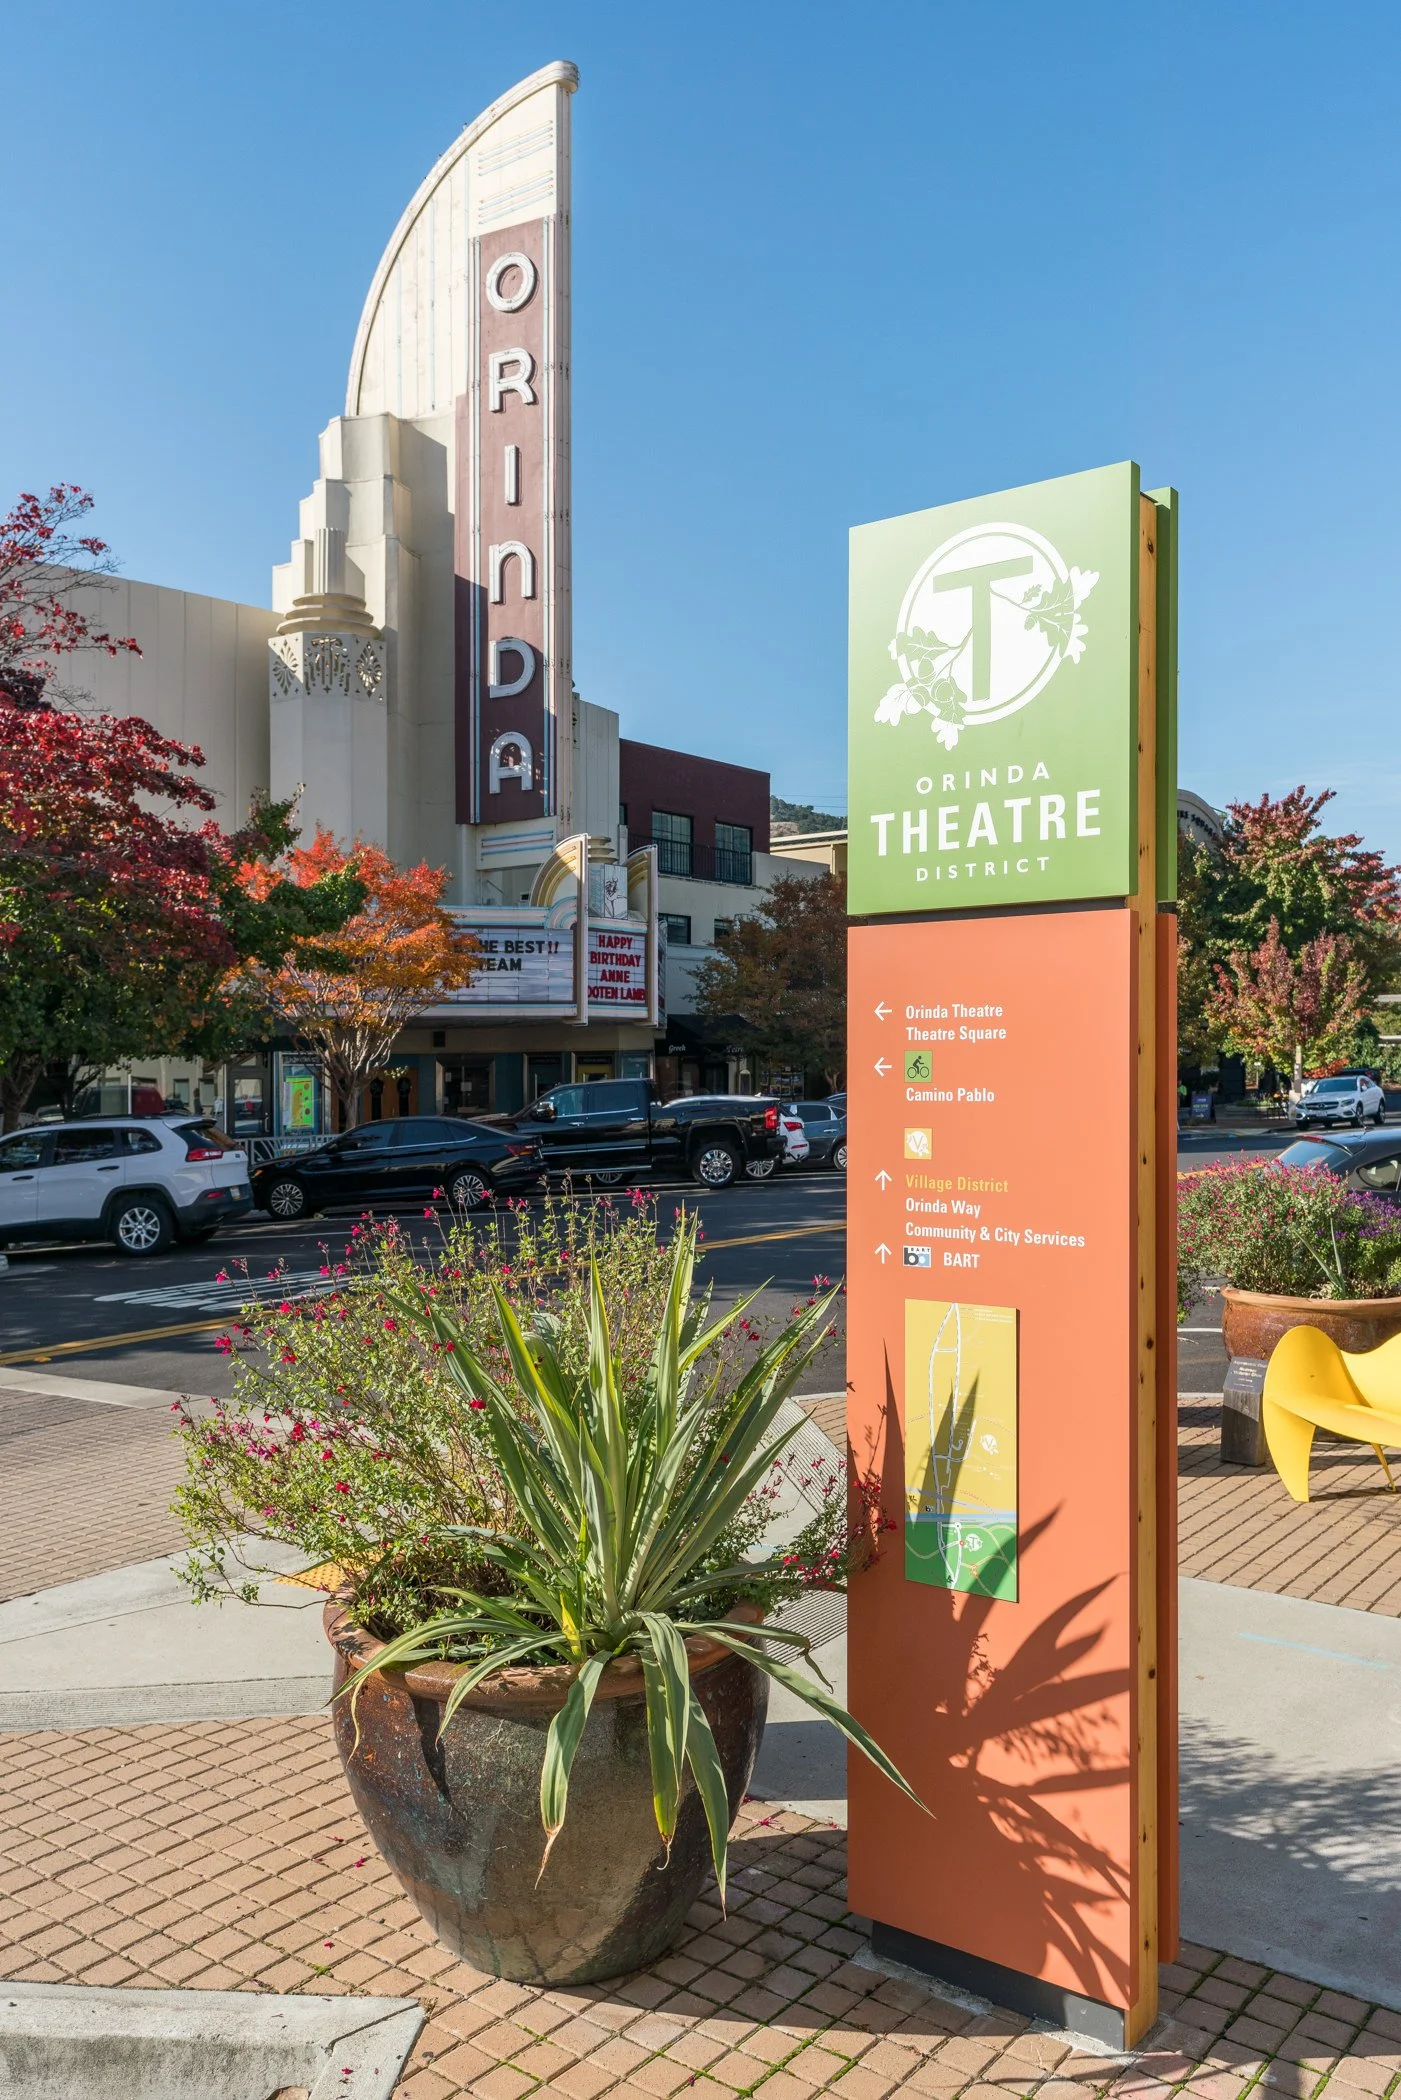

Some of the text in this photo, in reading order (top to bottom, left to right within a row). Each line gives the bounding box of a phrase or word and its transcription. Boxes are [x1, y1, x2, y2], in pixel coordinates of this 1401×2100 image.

[916, 762, 1049, 794] ORINDA
[870, 789, 1101, 856] THEATRE
[916, 856, 1049, 881] DISTRICT
[598, 935, 633, 949] HAPPY
[590, 951, 641, 967] BIRTHDAY
[600, 969, 630, 983] ANNE
[906, 1004, 1003, 1019] Orinda Theatre
[906, 1026, 1007, 1043] Theatre Square
[906, 1087, 995, 1102] Camino Pablo
[905, 1174, 1009, 1192] Village District
[906, 1197, 981, 1218] Orinda Way
[906, 1222, 1085, 1247] Community & City Services
[943, 1252, 981, 1268] BART
